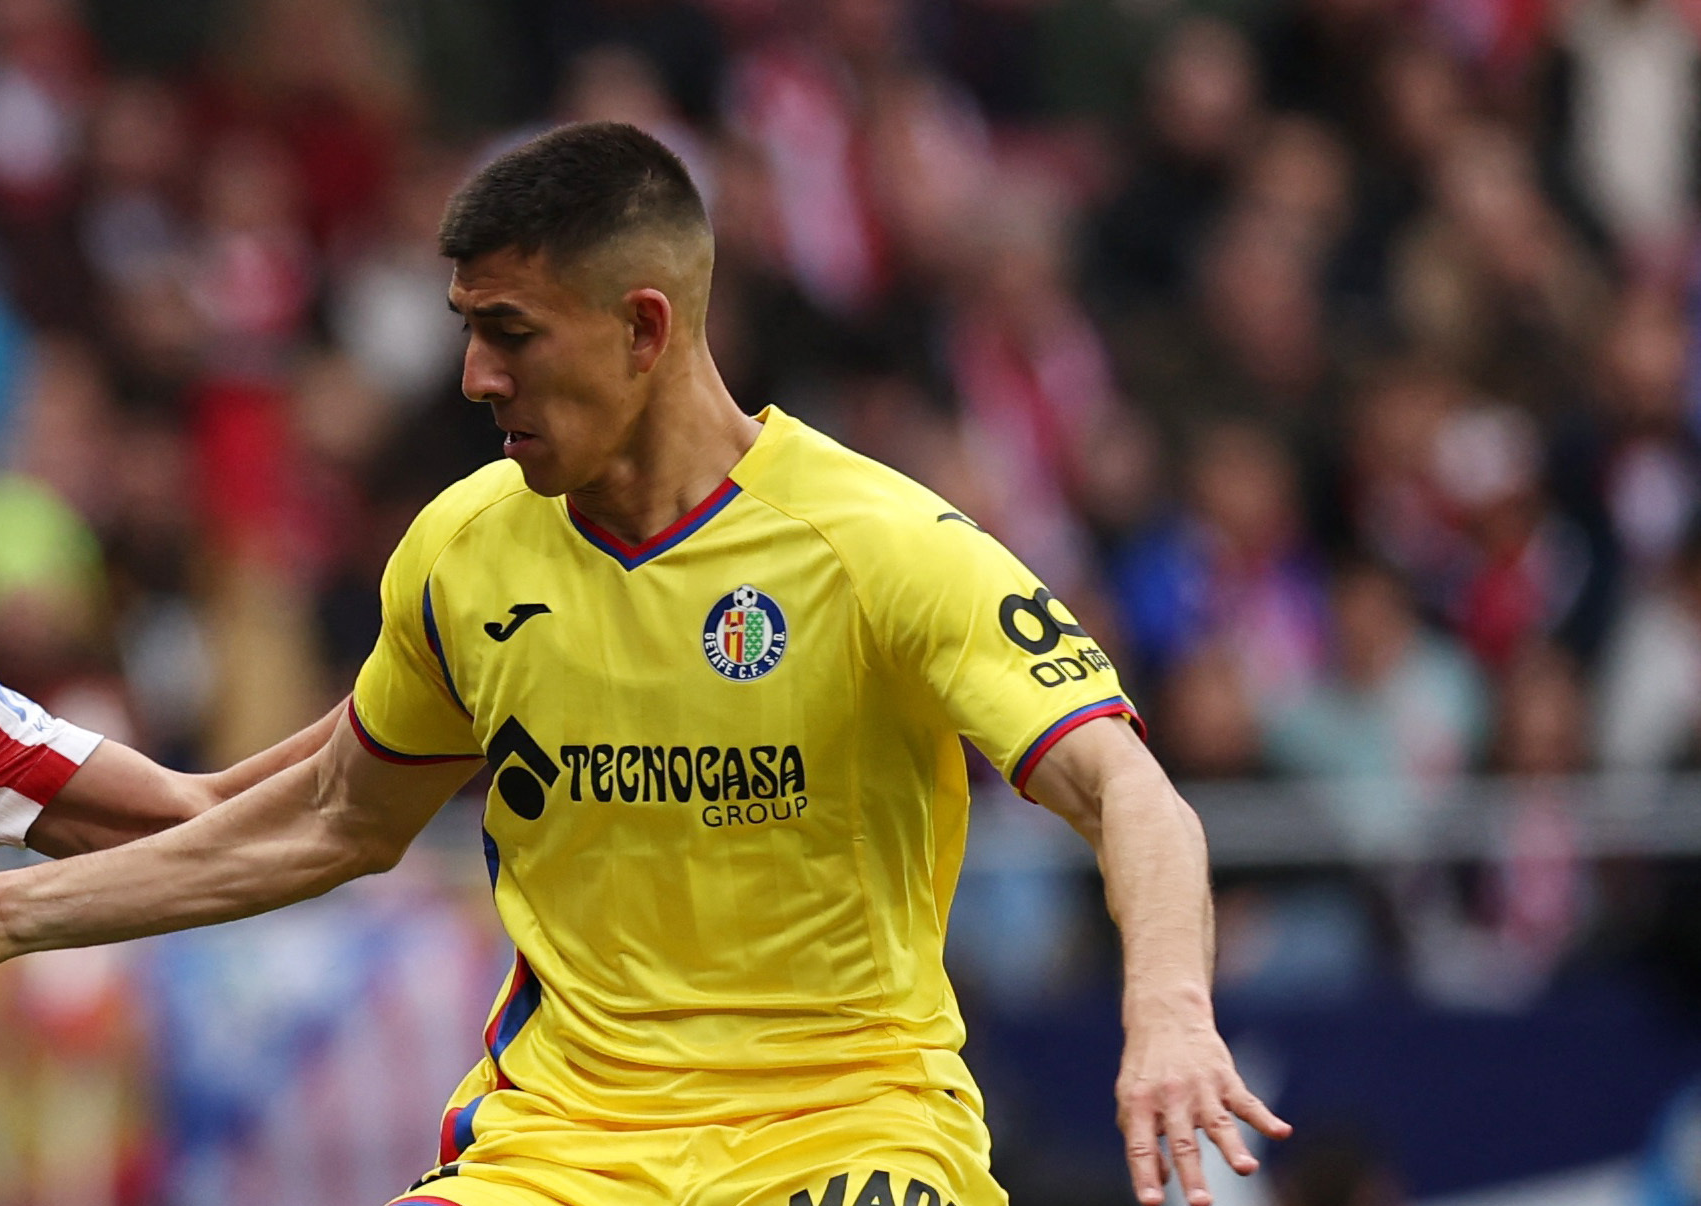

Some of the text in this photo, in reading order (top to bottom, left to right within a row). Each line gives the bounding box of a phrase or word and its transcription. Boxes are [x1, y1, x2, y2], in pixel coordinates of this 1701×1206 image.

[704, 631, 786, 679] GETAFE C.F. S.A.D.
[560, 744, 805, 803] TECNOCASA
[702, 796, 808, 828] GROUP
